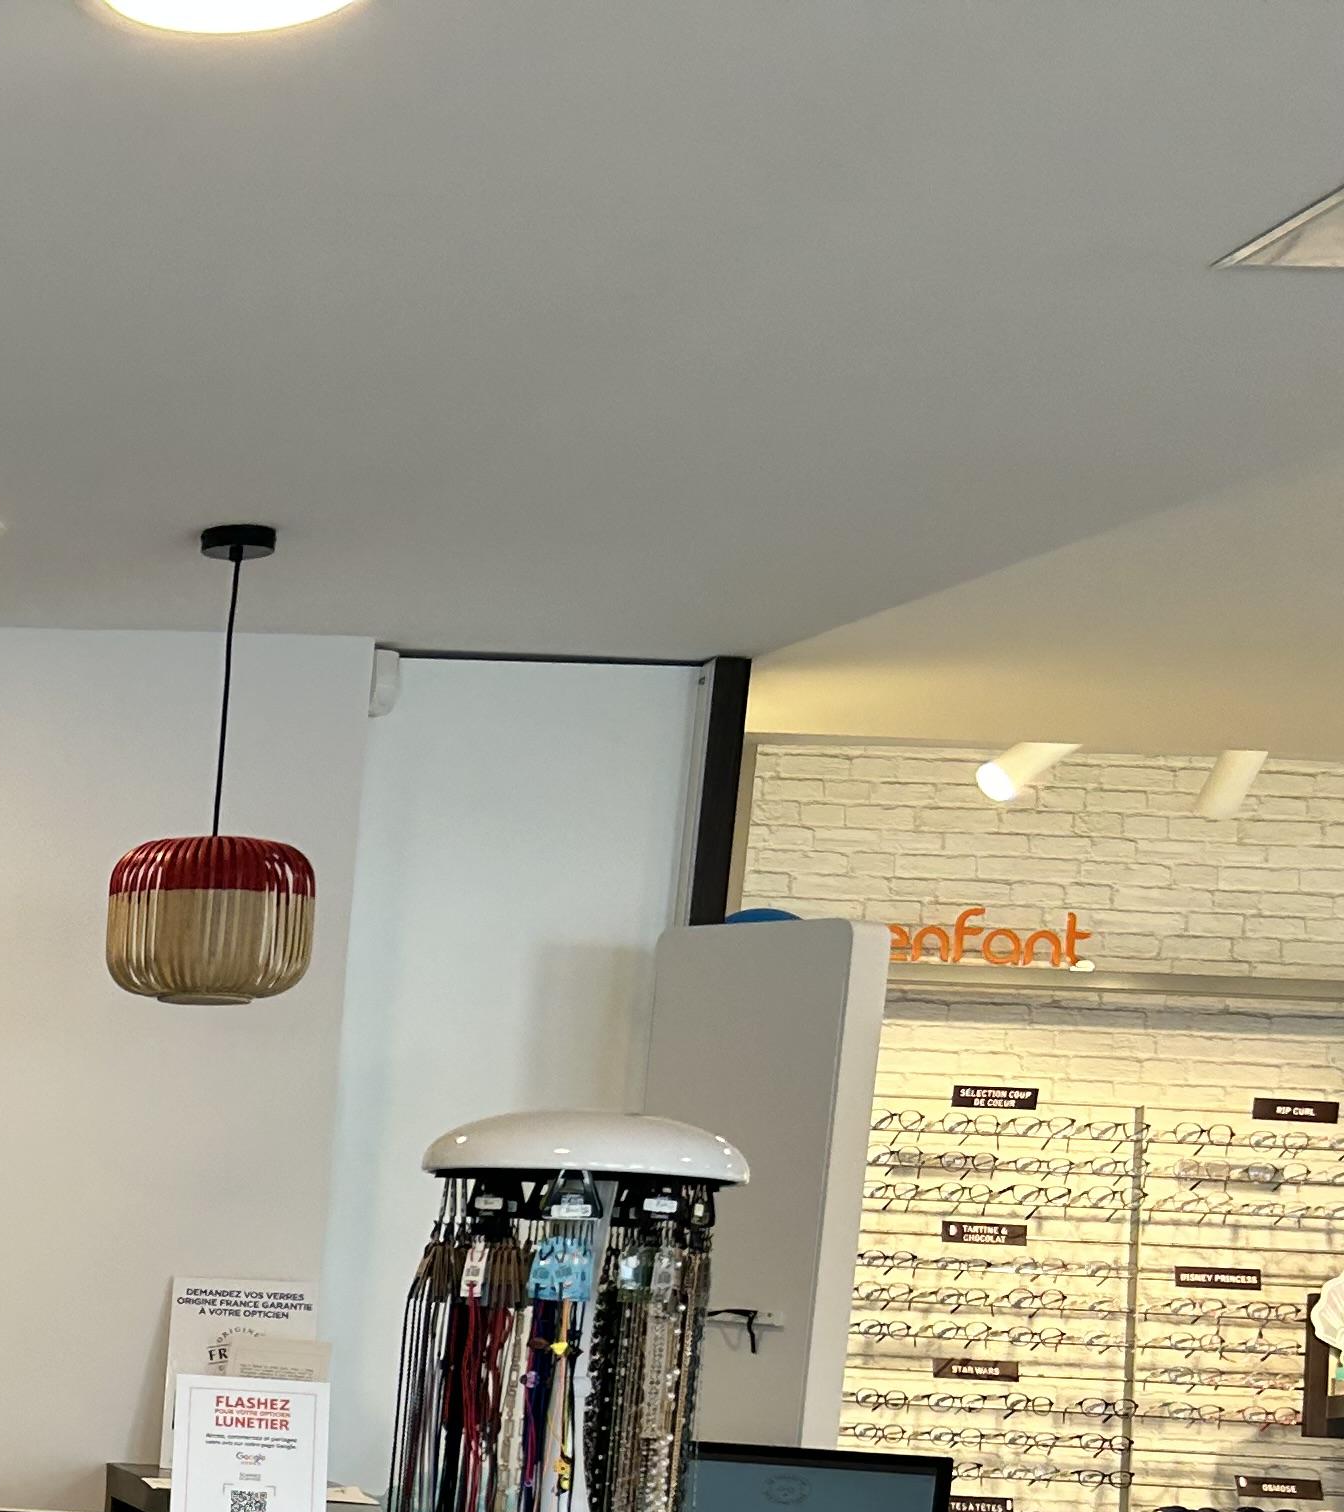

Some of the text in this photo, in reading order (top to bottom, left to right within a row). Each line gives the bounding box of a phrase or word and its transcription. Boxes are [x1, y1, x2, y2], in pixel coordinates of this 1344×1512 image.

[888, 907, 1092, 967] enfant
[959, 1088, 1032, 1099] SÉLECTION COUP
[973, 1098, 1016, 1107] DE COEUR
[1276, 1106, 1316, 1117] RIP CURL
[962, 1225, 1008, 1236] TARTINE &
[963, 1234, 1006, 1243] CHOCOLAT
[186, 1288, 305, 1301] DEMANDEZ VOS VERRES
[177, 1296, 313, 1311] ORIGINE FRANCE GARANTIE
[209, 1308, 241, 1317] VOTRE
[243, 1310, 289, 1320] OPTICIEN
[952, 1365, 1000, 1376] STAR WARS
[215, 1395, 291, 1411] FLASHEZ
[215, 1416, 290, 1431] LUNETIER
[235, 1451, 266, 1464] Google
